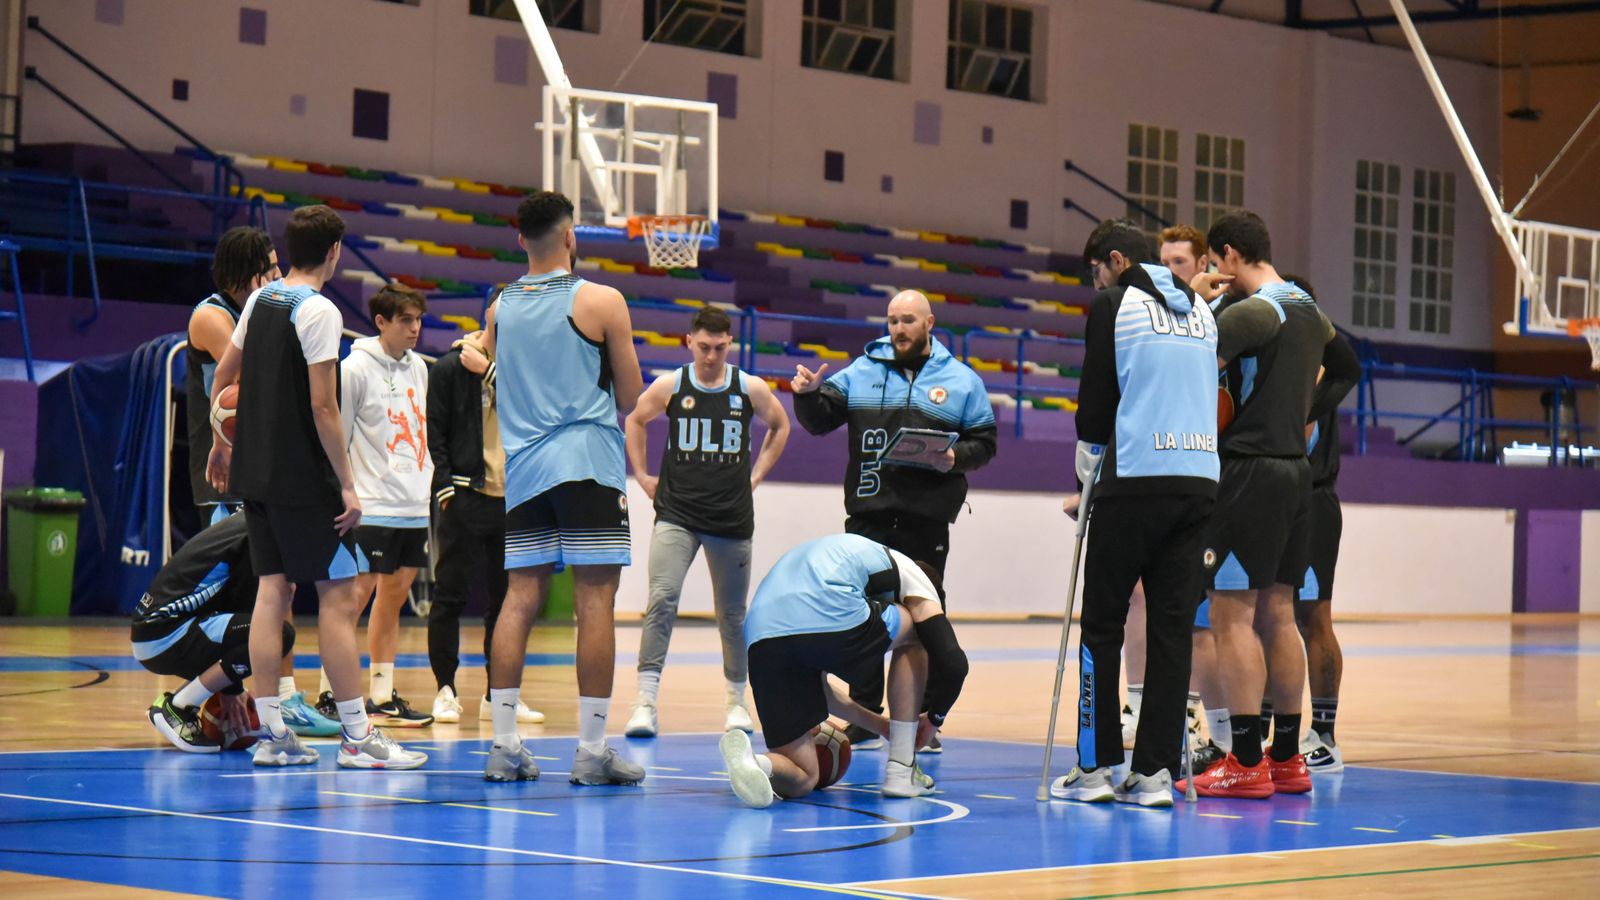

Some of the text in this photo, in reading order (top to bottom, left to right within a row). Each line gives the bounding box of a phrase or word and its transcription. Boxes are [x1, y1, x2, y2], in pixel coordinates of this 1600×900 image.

[1143, 300, 1206, 340] ULB
[678, 418, 742, 453] ULB
[1153, 432, 1178, 450] LA
[857, 428, 888, 497] ULB
